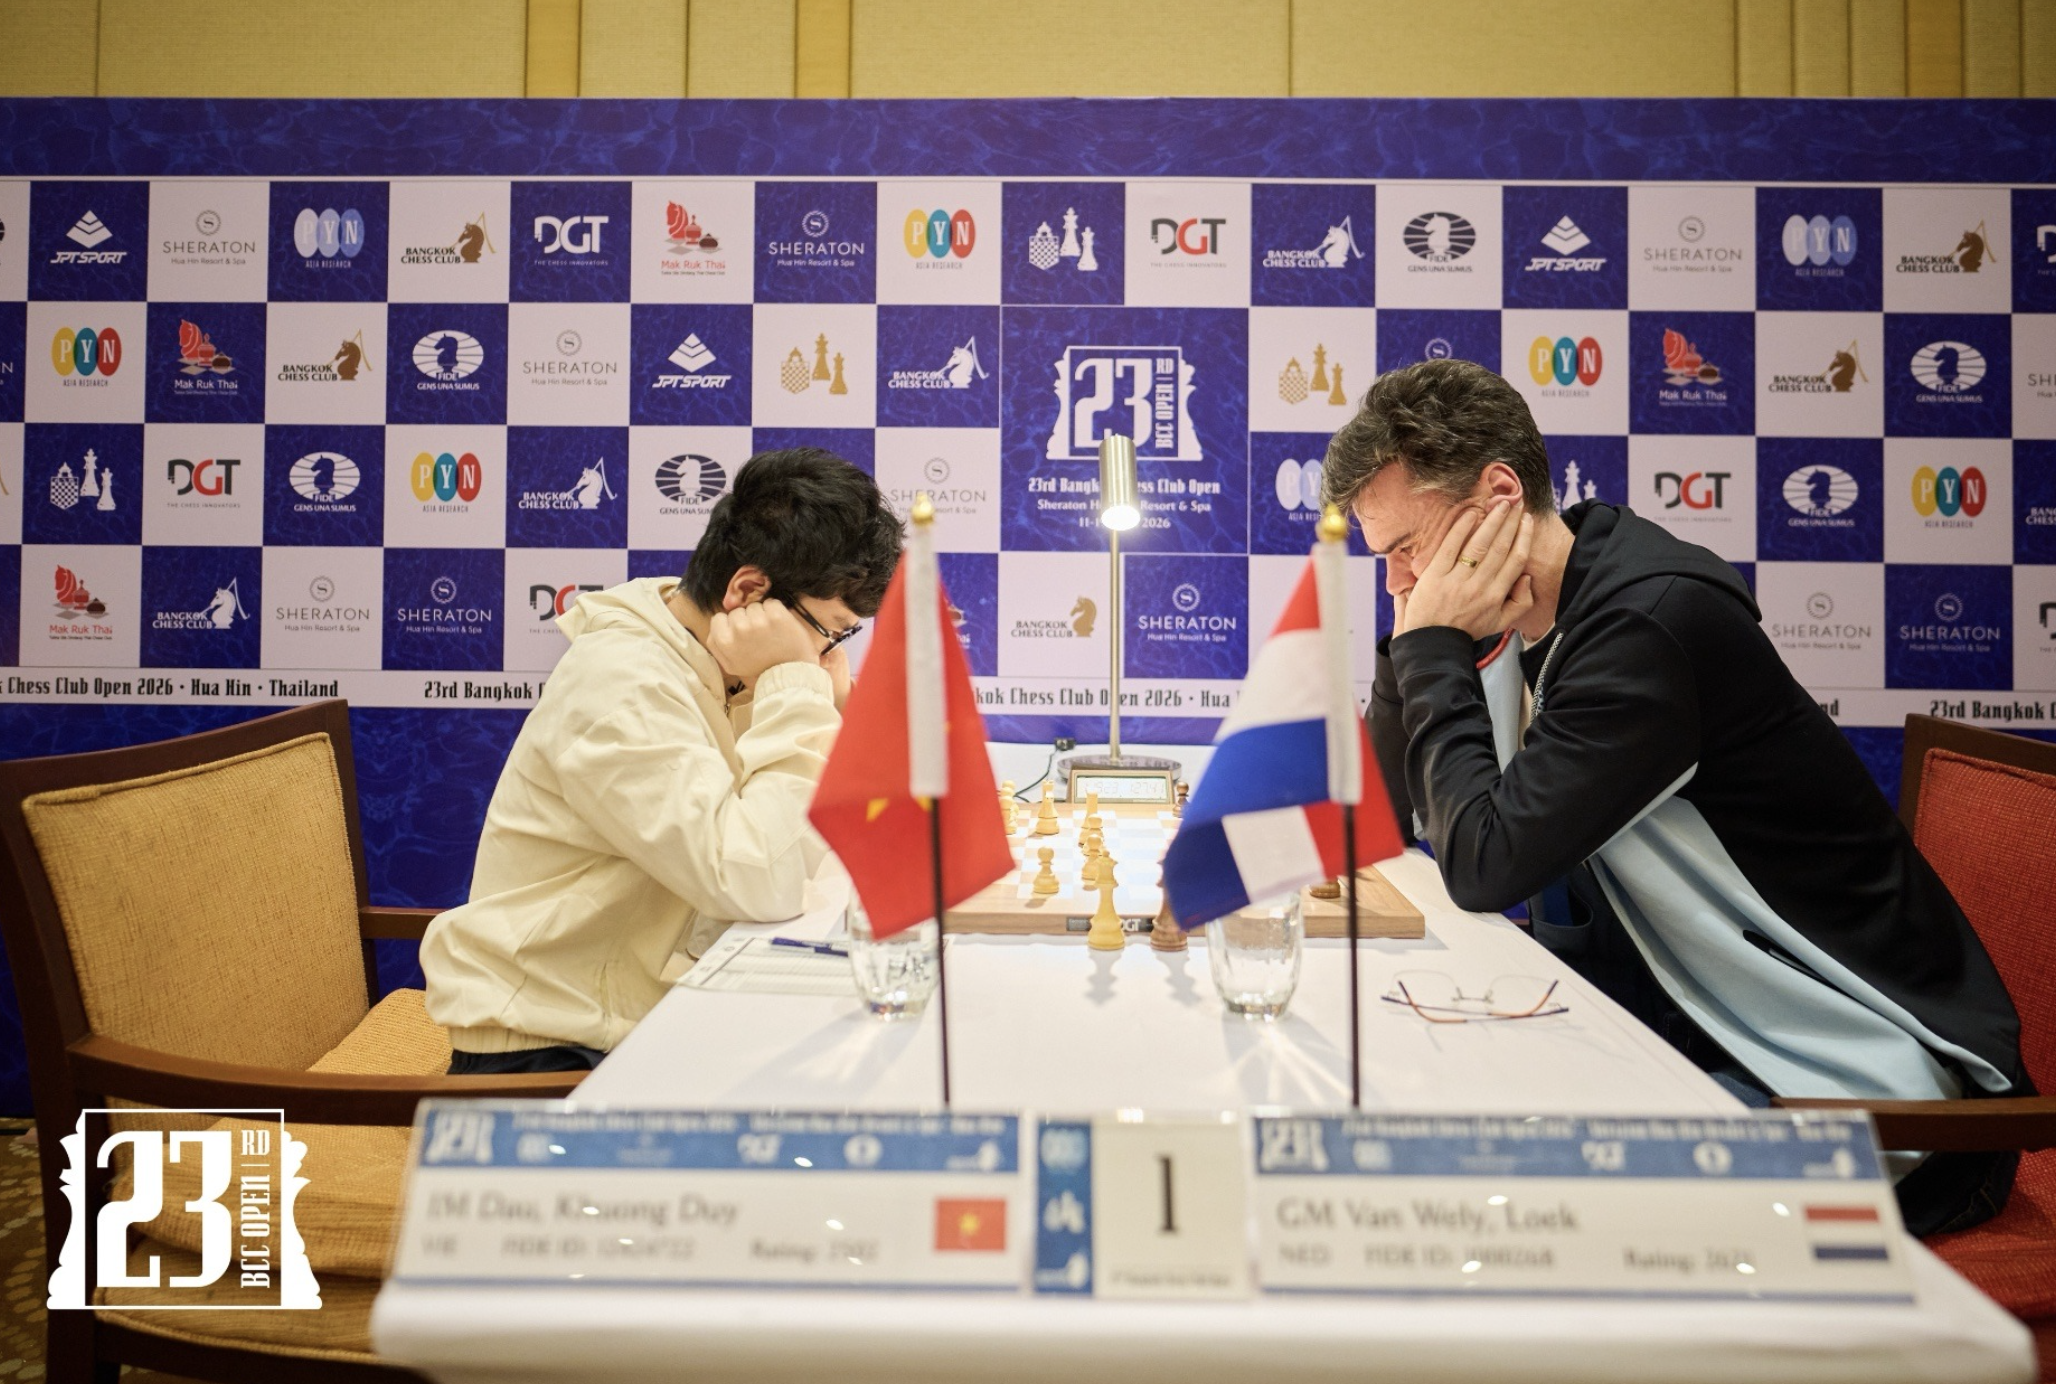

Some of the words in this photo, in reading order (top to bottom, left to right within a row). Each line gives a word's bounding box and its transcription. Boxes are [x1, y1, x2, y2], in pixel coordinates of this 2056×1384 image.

[302, 222, 359, 245] PYN
[534, 216, 609, 254] DGT
[912, 223, 970, 246] PYN
[1151, 218, 1227, 256] DGT
[1792, 228, 1850, 253] PYN
[163, 241, 256, 254] SHERATON
[405, 247, 456, 256] BANGKOK
[769, 241, 864, 256] SHERATON
[1644, 247, 1742, 261] SHERATON
[401, 255, 432, 264] CHESS
[435, 255, 461, 264] CLUB
[1268, 250, 1320, 260] BANGKOK
[1429, 254, 1449, 263] FIDE
[1901, 256, 1954, 264] BANGKOK
[661, 260, 680, 270] Mak
[684, 260, 702, 270] Ruk
[705, 260, 725, 270] Thai
[1263, 258, 1296, 268] CHESS
[1298, 258, 1326, 268] CLUB
[1896, 264, 1929, 273] CHESS
[1932, 264, 1960, 273] CLUB
[59, 338, 115, 363] PYN
[522, 361, 617, 374] SHERATON
[1156, 358, 1173, 374] RD
[1537, 349, 1595, 373] PYN
[282, 365, 333, 373] BANGKOK
[893, 371, 945, 380] BANGKOK
[278, 373, 309, 382] CHESS
[312, 373, 338, 382] CLUB
[438, 373, 458, 381] FIDE
[888, 379, 921, 388] CHESS
[923, 379, 950, 388] CLUB
[1773, 375, 1827, 384] BANGKOK
[174, 379, 193, 390] Mak
[196, 379, 214, 390] Ruk
[217, 379, 238, 390] Thai
[1769, 383, 1802, 393] CHESS
[1804, 383, 1832, 393] CLUB
[1660, 390, 1680, 400] Mak
[1683, 390, 1702, 400] Ruk
[1705, 390, 1727, 400] Thai
[1075, 358, 1152, 448] 23
[1156, 384, 1173, 420] OPEN
[1156, 423, 1173, 448] BCC
[168, 459, 241, 495] DGT
[419, 465, 475, 488] PYN
[1029, 478, 1056, 493] 23rd
[1060, 478, 1100, 495] Bangk
[1157, 478, 1185, 493] Club
[1188, 479, 1220, 495] Open
[1655, 472, 1731, 509] DGT
[1920, 479, 1980, 504] PYN
[315, 494, 336, 502] FIDE
[523, 491, 574, 501] BANGKOK
[680, 496, 701, 505] FIDE
[518, 500, 550, 509] CHESS
[552, 500, 579, 509] CLUB
[1037, 499, 1086, 510] Sheraton
[1141, 500, 1175, 510] Resort
[1179, 501, 1187, 510] &
[1191, 501, 1211, 512] Spa
[1079, 518, 1100, 527] 11-1
[1142, 518, 1171, 528] 2026
[157, 612, 207, 620] BANGKOK
[276, 608, 370, 621] SHERATON
[397, 609, 492, 622] SHERATON
[49, 624, 68, 634] Mak
[71, 624, 89, 634] Ruk
[92, 624, 113, 634] Thai
[152, 620, 184, 629] CHESS
[186, 620, 212, 629] CLUB
[1016, 621, 1067, 629] BANGKOK
[1138, 616, 1236, 630] SHERATON
[1011, 629, 1043, 638] CHESS
[1046, 629, 1073, 638] CLUB
[1772, 624, 1871, 638] SHERATON
[1900, 625, 2000, 640] SHERATON
[8, 677, 50, 697] Chess
[56, 677, 89, 697] Club
[94, 677, 133, 700] Open
[137, 677, 173, 696] 2026
[191, 679, 220, 697] Hua
[225, 679, 251, 697] Hin
[269, 679, 338, 698] Thailand
[424, 681, 458, 699] 23rd
[464, 681, 533, 701] Bangkok
[1011, 689, 1054, 707] Chess
[1060, 689, 1093, 707] Club
[1100, 690, 1138, 709] Oen
[1145, 689, 1182, 707] 2026
[1201, 690, 1230, 708] Hua
[1930, 700, 1965, 719] 23rd
[1972, 701, 2042, 722] Bangkok
[1157, 1154, 1180, 1236] 1
[1276, 1196, 1335, 1229] GM
[1343, 1197, 1402, 1229] Van
[1504, 1200, 1580, 1231] Loek
